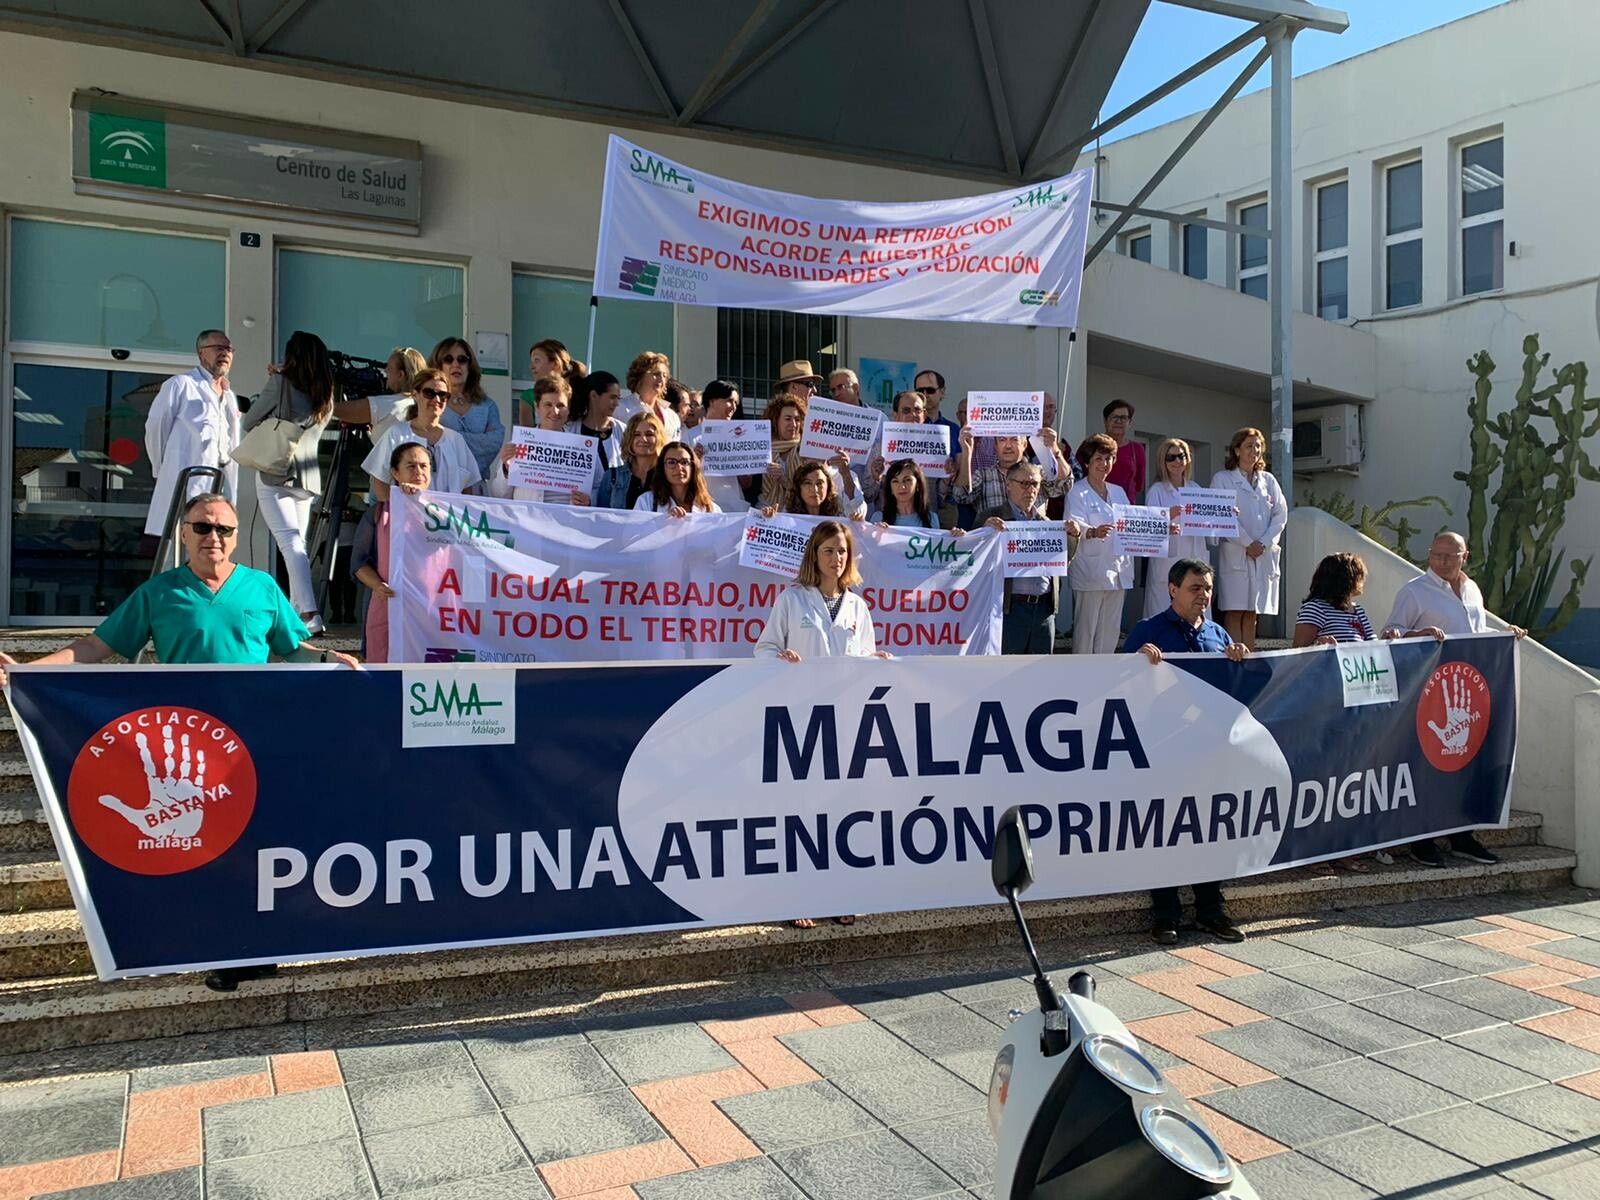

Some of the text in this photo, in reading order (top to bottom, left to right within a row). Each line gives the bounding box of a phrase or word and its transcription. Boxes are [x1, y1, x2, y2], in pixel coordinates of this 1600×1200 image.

[276, 155, 407, 191] Centro de Salud
[341, 185, 406, 207] Las Lagunas
[698, 200, 1013, 244] EXIGIMOS UNA RETRIBUCIÓN
[247, 234, 254, 246] 2
[741, 236, 832, 264] ACORDE
[837, 248, 853, 265] A
[658, 240, 890, 285] RESPONSABILIDADES
[663, 263, 709, 282] SINDICATO
[970, 407, 1040, 421] #PROMESAS
[980, 414, 1040, 422] INCUMPLIDAS
[810, 418, 872, 435] #PROMESAS
[819, 427, 871, 442] INCUMPLIDAS
[515, 443, 593, 463] #PROMESAS
[806, 440, 842, 452] PRIMARIA
[887, 439, 947, 453] #PROMESAS
[896, 447, 948, 456] INCUMPLIDAS
[527, 453, 593, 470] INCUMPLIDAS
[1185, 503, 1232, 515] #PROMESAS
[1192, 510, 1233, 518] INCUMPLIDAS
[1116, 519, 1168, 532] #PROMESAS
[1124, 526, 1168, 535] INCUMPLIDAS
[905, 536, 973, 563] SMA
[1007, 539, 1063, 553] #PROMESAS
[437, 567, 462, 595] A
[490, 571, 590, 604] IGUAL
[864, 587, 969, 613] SUELDO
[438, 606, 482, 636] EN
[492, 609, 589, 641] TODO
[600, 615, 633, 642] EL
[479, 649, 536, 663] SINDICATO
[1342, 655, 1390, 684] SMA
[1423, 665, 1486, 696] ASOCIACIÓN
[409, 679, 503, 719] SMA
[411, 720, 444, 729] Sindicato
[471, 725, 506, 736] Málaga
[1443, 710, 1482, 741] BASTA YA
[89, 711, 239, 758] ASOCIACIÓN
[761, 685, 1151, 784] MÁLAGA
[1440, 744, 1468, 756] málaga
[144, 783, 233, 828] BASTA YA
[137, 834, 203, 851] málaga
[256, 762, 1418, 913] POR UNA ATENCIÓN PRIMARIA DIGNA
